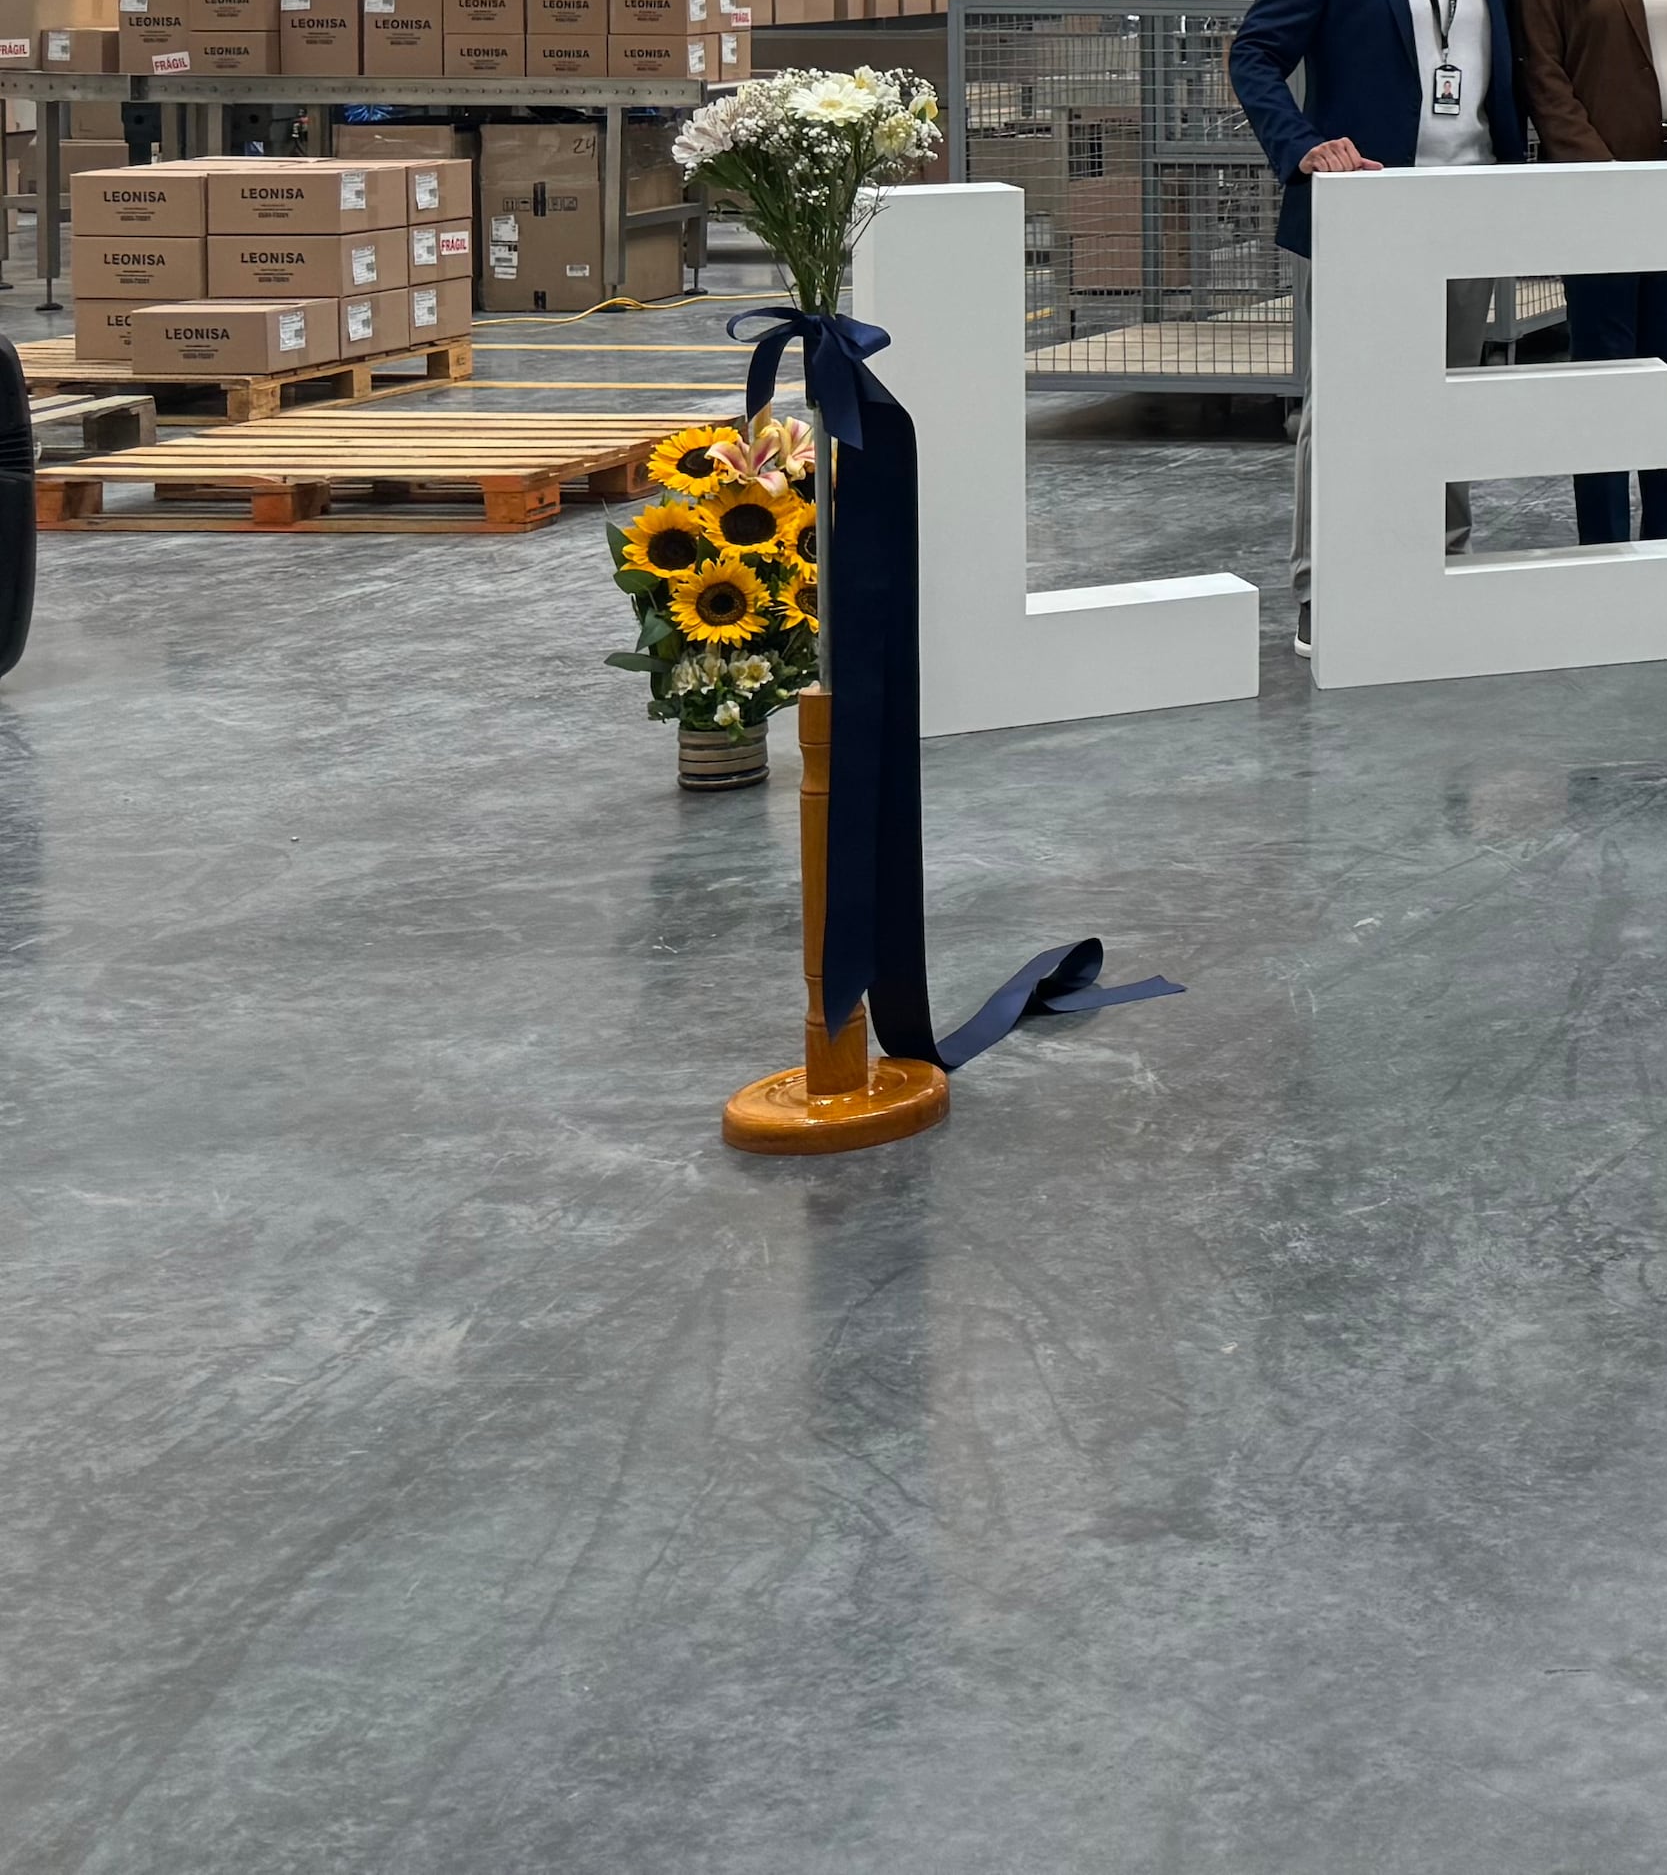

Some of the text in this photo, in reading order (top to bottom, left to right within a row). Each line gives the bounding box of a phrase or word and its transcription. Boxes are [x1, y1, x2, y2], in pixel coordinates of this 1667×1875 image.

[542, 0, 590, 9] LEONISA
[624, 0, 671, 9] LEONISA
[128, 16, 182, 28] LEONISA
[290, 18, 347, 29] LEONISA
[374, 19, 432, 30] LEONISA
[203, 46, 250, 56] LEONISA
[459, 47, 508, 58] LEONISA
[542, 49, 590, 59] LEONISA
[623, 49, 671, 59] LEONISA
[154, 56, 188, 72] FRÁGIL
[574, 136, 596, 157] 24
[103, 190, 167, 203] LEONISA
[240, 188, 305, 200] LEONISA
[103, 253, 166, 266] LEONISA
[240, 252, 305, 264] LEONISA
[165, 328, 231, 340] LEONISA
